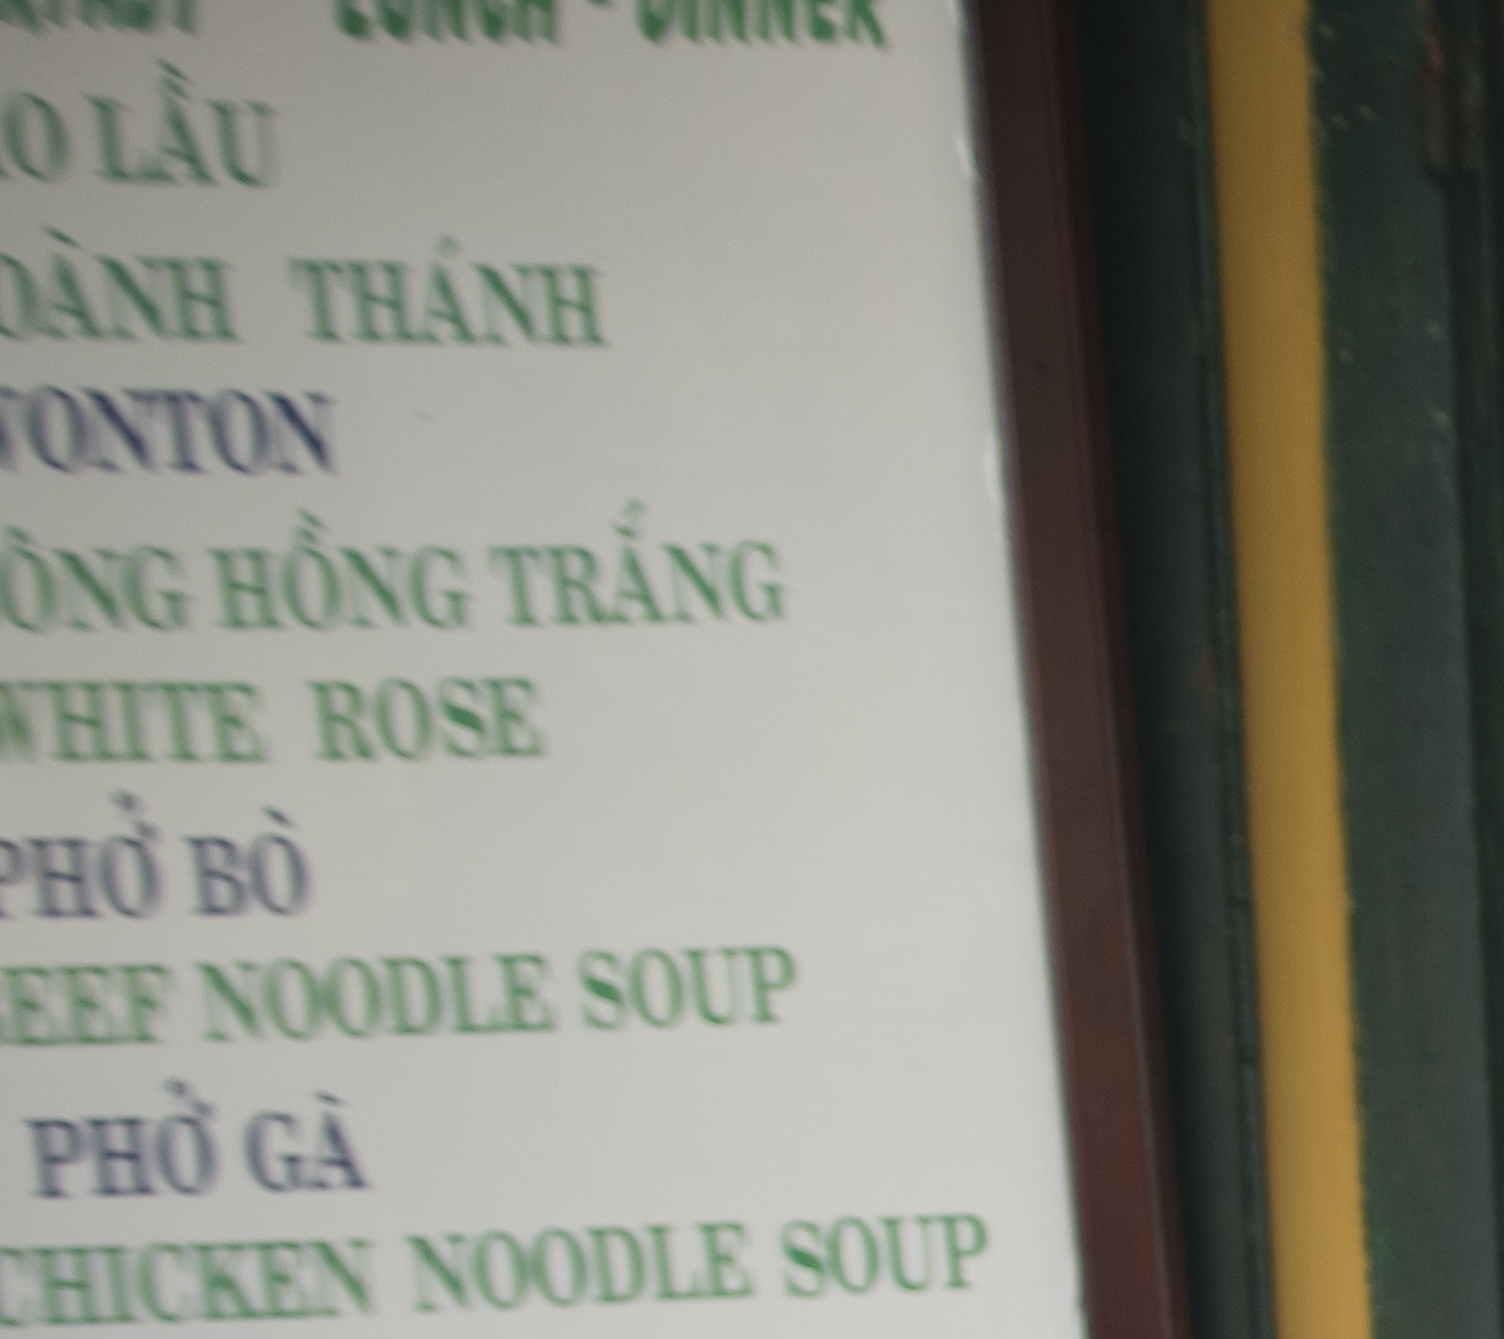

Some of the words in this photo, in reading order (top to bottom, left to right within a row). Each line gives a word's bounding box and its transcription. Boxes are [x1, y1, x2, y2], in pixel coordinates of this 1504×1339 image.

[0, 89, 72, 182] O
[308, 677, 545, 761] ROSE
[184, 807, 310, 917] BÒ
[197, 953, 556, 1042] NOODLE
[578, 945, 796, 1031] SOUP
[243, 1092, 369, 1192] GÀ
[404, 1222, 753, 1312] NOODLE
[780, 1214, 988, 1299] SOUP
